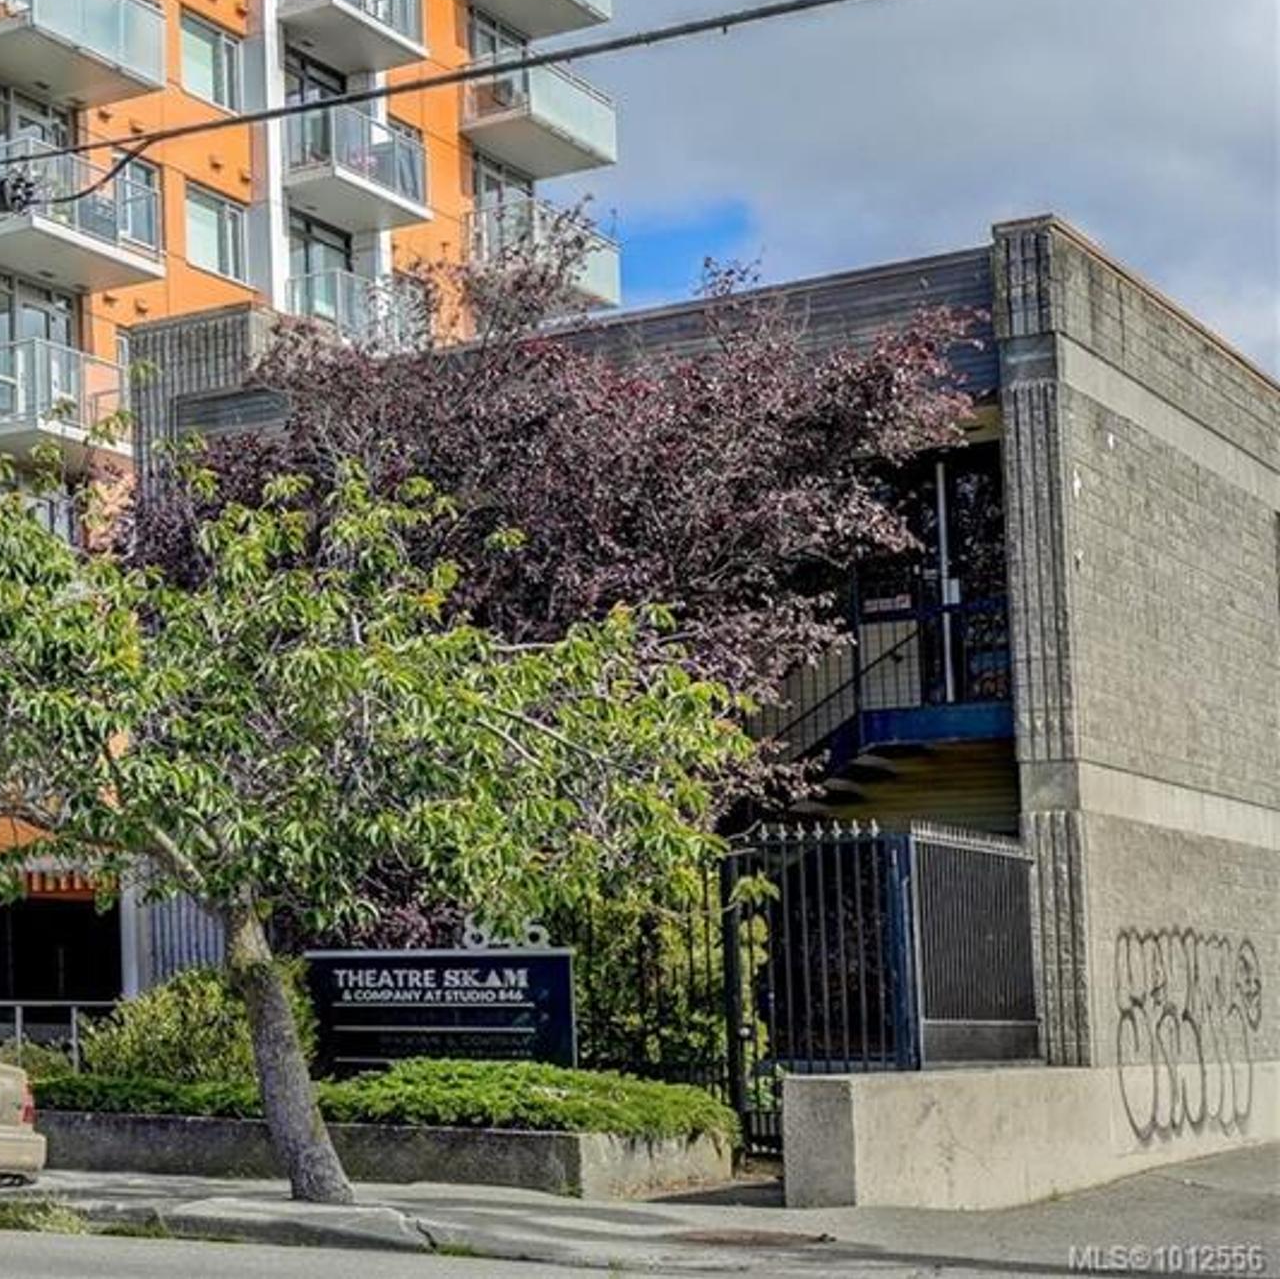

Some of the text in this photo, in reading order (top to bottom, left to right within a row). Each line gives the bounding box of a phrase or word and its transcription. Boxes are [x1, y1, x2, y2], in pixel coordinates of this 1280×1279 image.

[334, 968, 529, 989] THEATRE SKAM
[342, 990, 352, 1002] &
[354, 990, 423, 1002] COMPANY
[424, 990, 441, 1002] AT
[445, 989, 496, 1002] STUDIO
